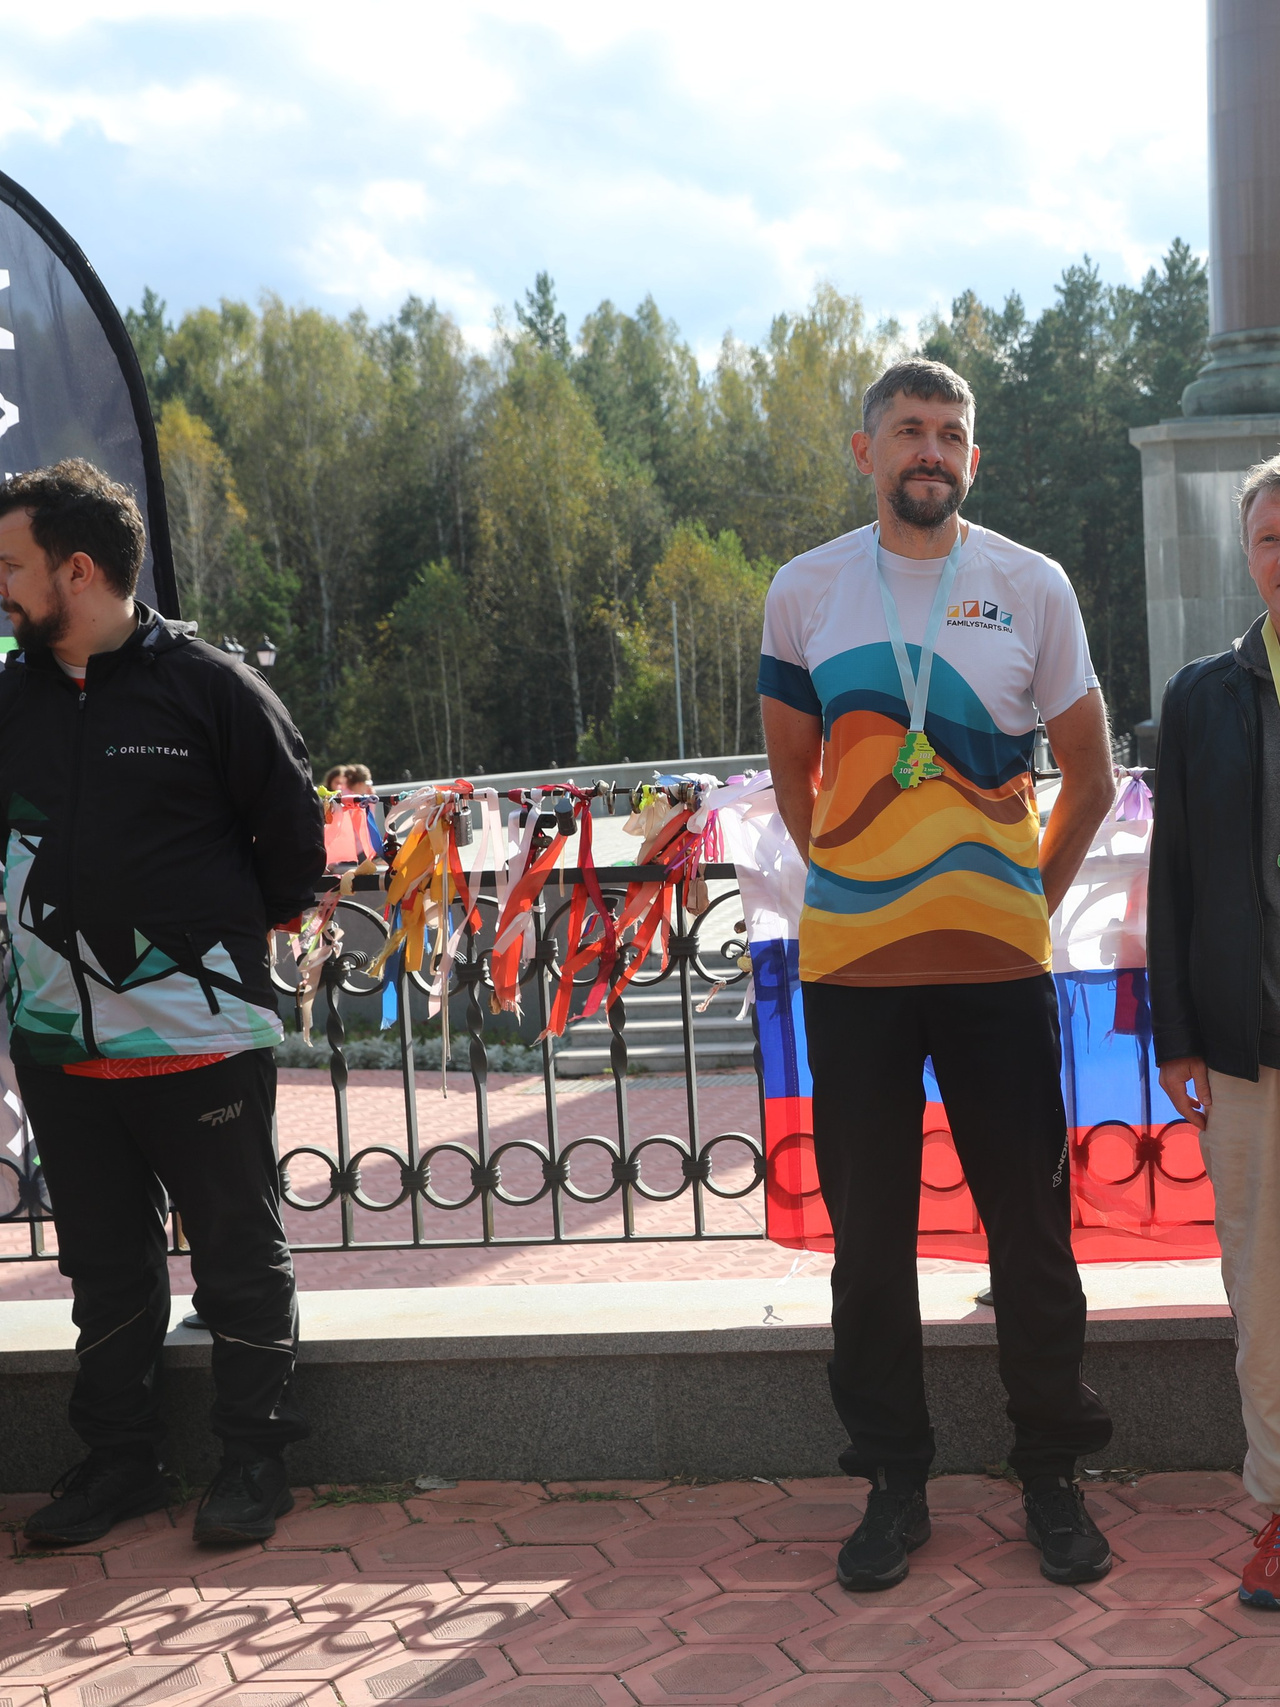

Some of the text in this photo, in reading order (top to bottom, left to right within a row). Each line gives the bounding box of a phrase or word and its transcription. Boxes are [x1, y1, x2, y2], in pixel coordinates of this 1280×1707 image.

[946, 620, 1013, 634] FAMILYSTARTS.RU
[120, 746, 189, 757] ORIENTEAM
[198, 1100, 243, 1126] RAY
